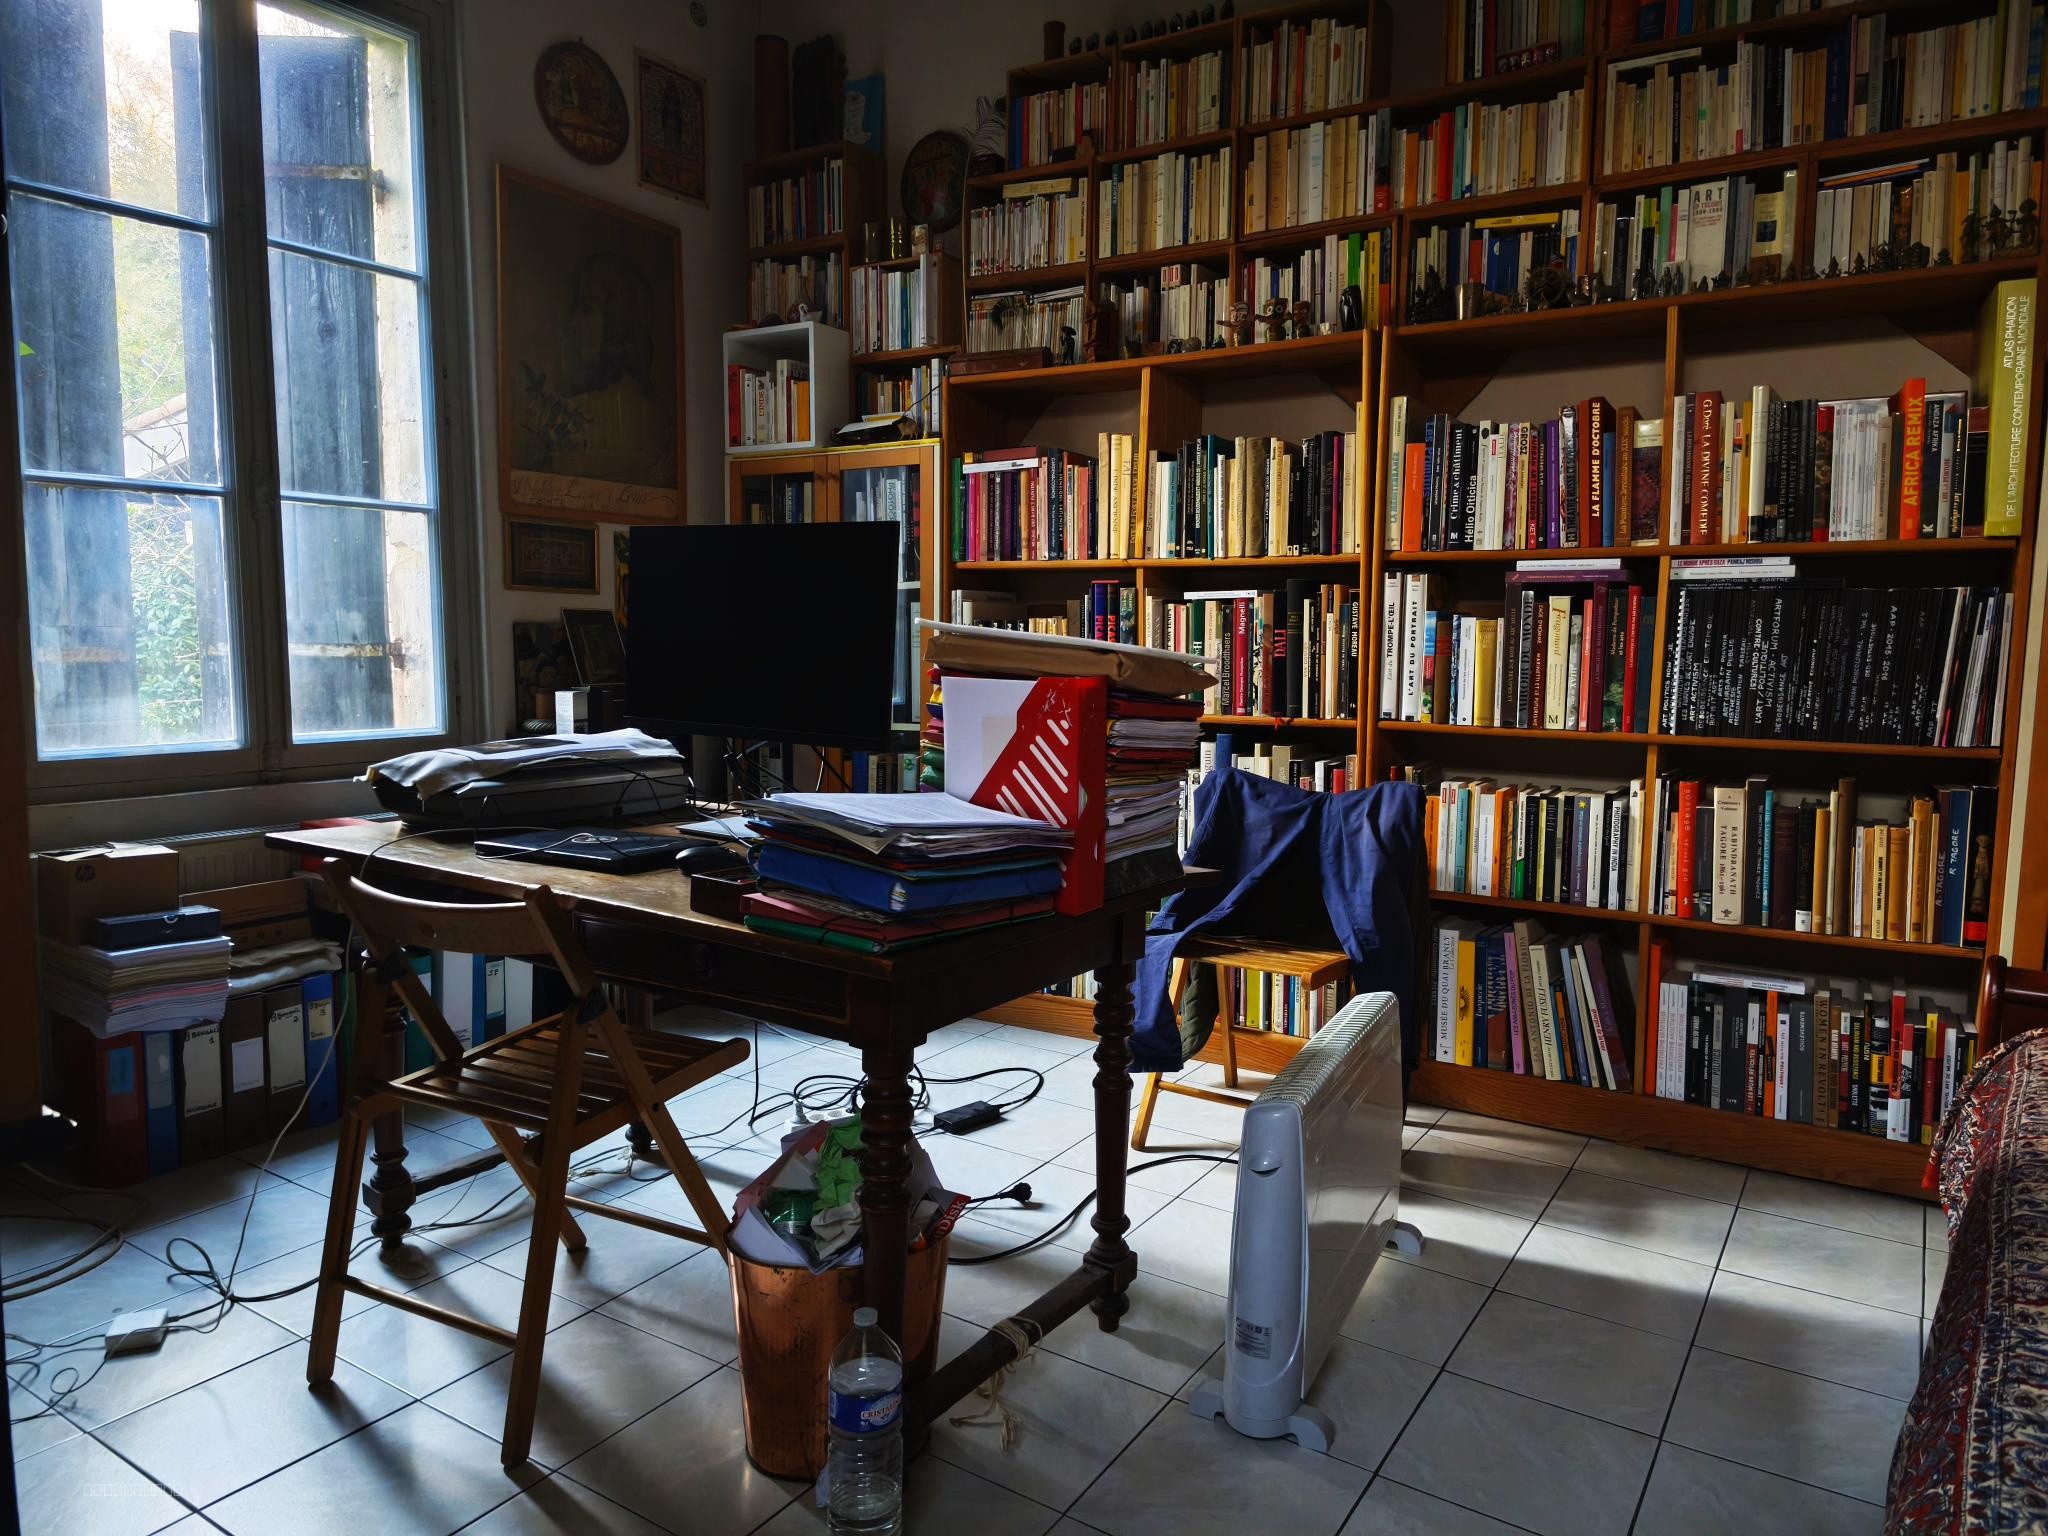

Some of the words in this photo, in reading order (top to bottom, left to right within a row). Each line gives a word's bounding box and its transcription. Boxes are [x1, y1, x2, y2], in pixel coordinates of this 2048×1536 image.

[1694, 187, 1724, 202] ART
[2004, 297, 2016, 339] PHAIDON
[2017, 296, 2030, 344] MONDIALE
[2003, 341, 2013, 368] ATLAS
[2013, 346, 2027, 426] CONTEMPORAINE
[1592, 402, 1600, 455] D'OCTOBRE
[1906, 396, 1922, 446] REMIX
[1932, 404, 1940, 429] ANGAZA
[1451, 428, 1463, 480] châtiment
[1520, 427, 1528, 455] GROSZ
[1702, 435, 1709, 446] LA
[1592, 459, 1600, 500] FLAMME
[1701, 451, 1711, 486] DIVINE
[1904, 450, 1920, 505] AFRICA
[1943, 458, 1951, 483] PEINTURE
[2007, 428, 2022, 503] L'ARCHITECTURE
[1466, 475, 1477, 513] Oiticica
[1779, 471, 1788, 505] PEINTURE
[1390, 513, 1397, 523] LA
[1450, 489, 1460, 520] Crime
[1592, 504, 1600, 517] LA
[1780, 508, 1786, 516] LA
[1789, 507, 1795, 518] LA
[2007, 505, 2016, 517] DE
[1464, 516, 1474, 543] Hélio
[1238, 601, 1247, 635] Magnelli
[1351, 602, 1359, 629] GUSTAVE
[1410, 600, 1418, 647] PORTRAIT
[1523, 598, 1533, 643] MONDE
[1612, 598, 1620, 625] Pompadour
[1770, 598, 1782, 650] ARTFORUM
[1890, 605, 1898, 627] AAP
[1274, 629, 1287, 657] DALI
[1386, 602, 1395, 657] TROMPE-L'ŒIL
[1552, 608, 1566, 657] Fragonard
[1885, 633, 1894, 655] 2015
[1222, 632, 1232, 678] Broodthaers
[1409, 653, 1415, 664] DU
[1521, 646, 1531, 662] DU
[1685, 651, 1693, 670] L'ART
[1720, 634, 1728, 663] POUVOIR
[1726, 639, 1734, 667] PUBLIC
[1780, 653, 1788, 668] ART
[1719, 665, 1725, 676] ET
[1758, 640, 1769, 690] POLITIQUE
[1881, 661, 1889, 681] 2016
[1222, 679, 1231, 706] Marcel
[1519, 666, 1530, 714] MIROIR
[1663, 680, 1671, 710] POLITICS
[1690, 662, 1700, 702] ACTIVISM
[1764, 660, 1776, 707] ACTIVISM
[1850, 685, 1858, 706] INDIAN
[1548, 715, 1558, 724] M
[1612, 806, 1620, 847] PHOTOGRAPHY
[1729, 826, 1738, 895] RABINDRANATH
[1950, 828, 1960, 864] TAGORE
[75, 865, 95, 882] hp
[1936, 850, 1946, 894] TAGORE
[1949, 867, 1957, 875] R
[1442, 936, 1450, 970] BRANLY
[1519, 936, 1530, 972] FLORIDA
[1441, 972, 1450, 993] QUAI
[1510, 982, 1517, 991] DU
[1523, 974, 1531, 985] LA
[1525, 986, 1532, 998] DE
[1441, 996, 1449, 1009] DU
[1510, 991, 1518, 1024] AMAZONES
[1538, 987, 1549, 1016] FUSELI
[1440, 1011, 1448, 1040] MUSÉE
[1526, 1000, 1538, 1042] ANTONIO
[1542, 1017, 1553, 1046] HENRY
[1591, 1008, 1600, 1028] georges
[1599, 1042, 1607, 1052] tour
[1798, 1011, 1806, 1051] SOULÈVEMENTS
[1818, 999, 1828, 1043] WOMEN
[1533, 1046, 1541, 1063] SAN
[1713, 1049, 1721, 1076] POLITICS
[1819, 1047, 1829, 1060] IN
[861, 1393, 902, 1419] CRISTALINE
